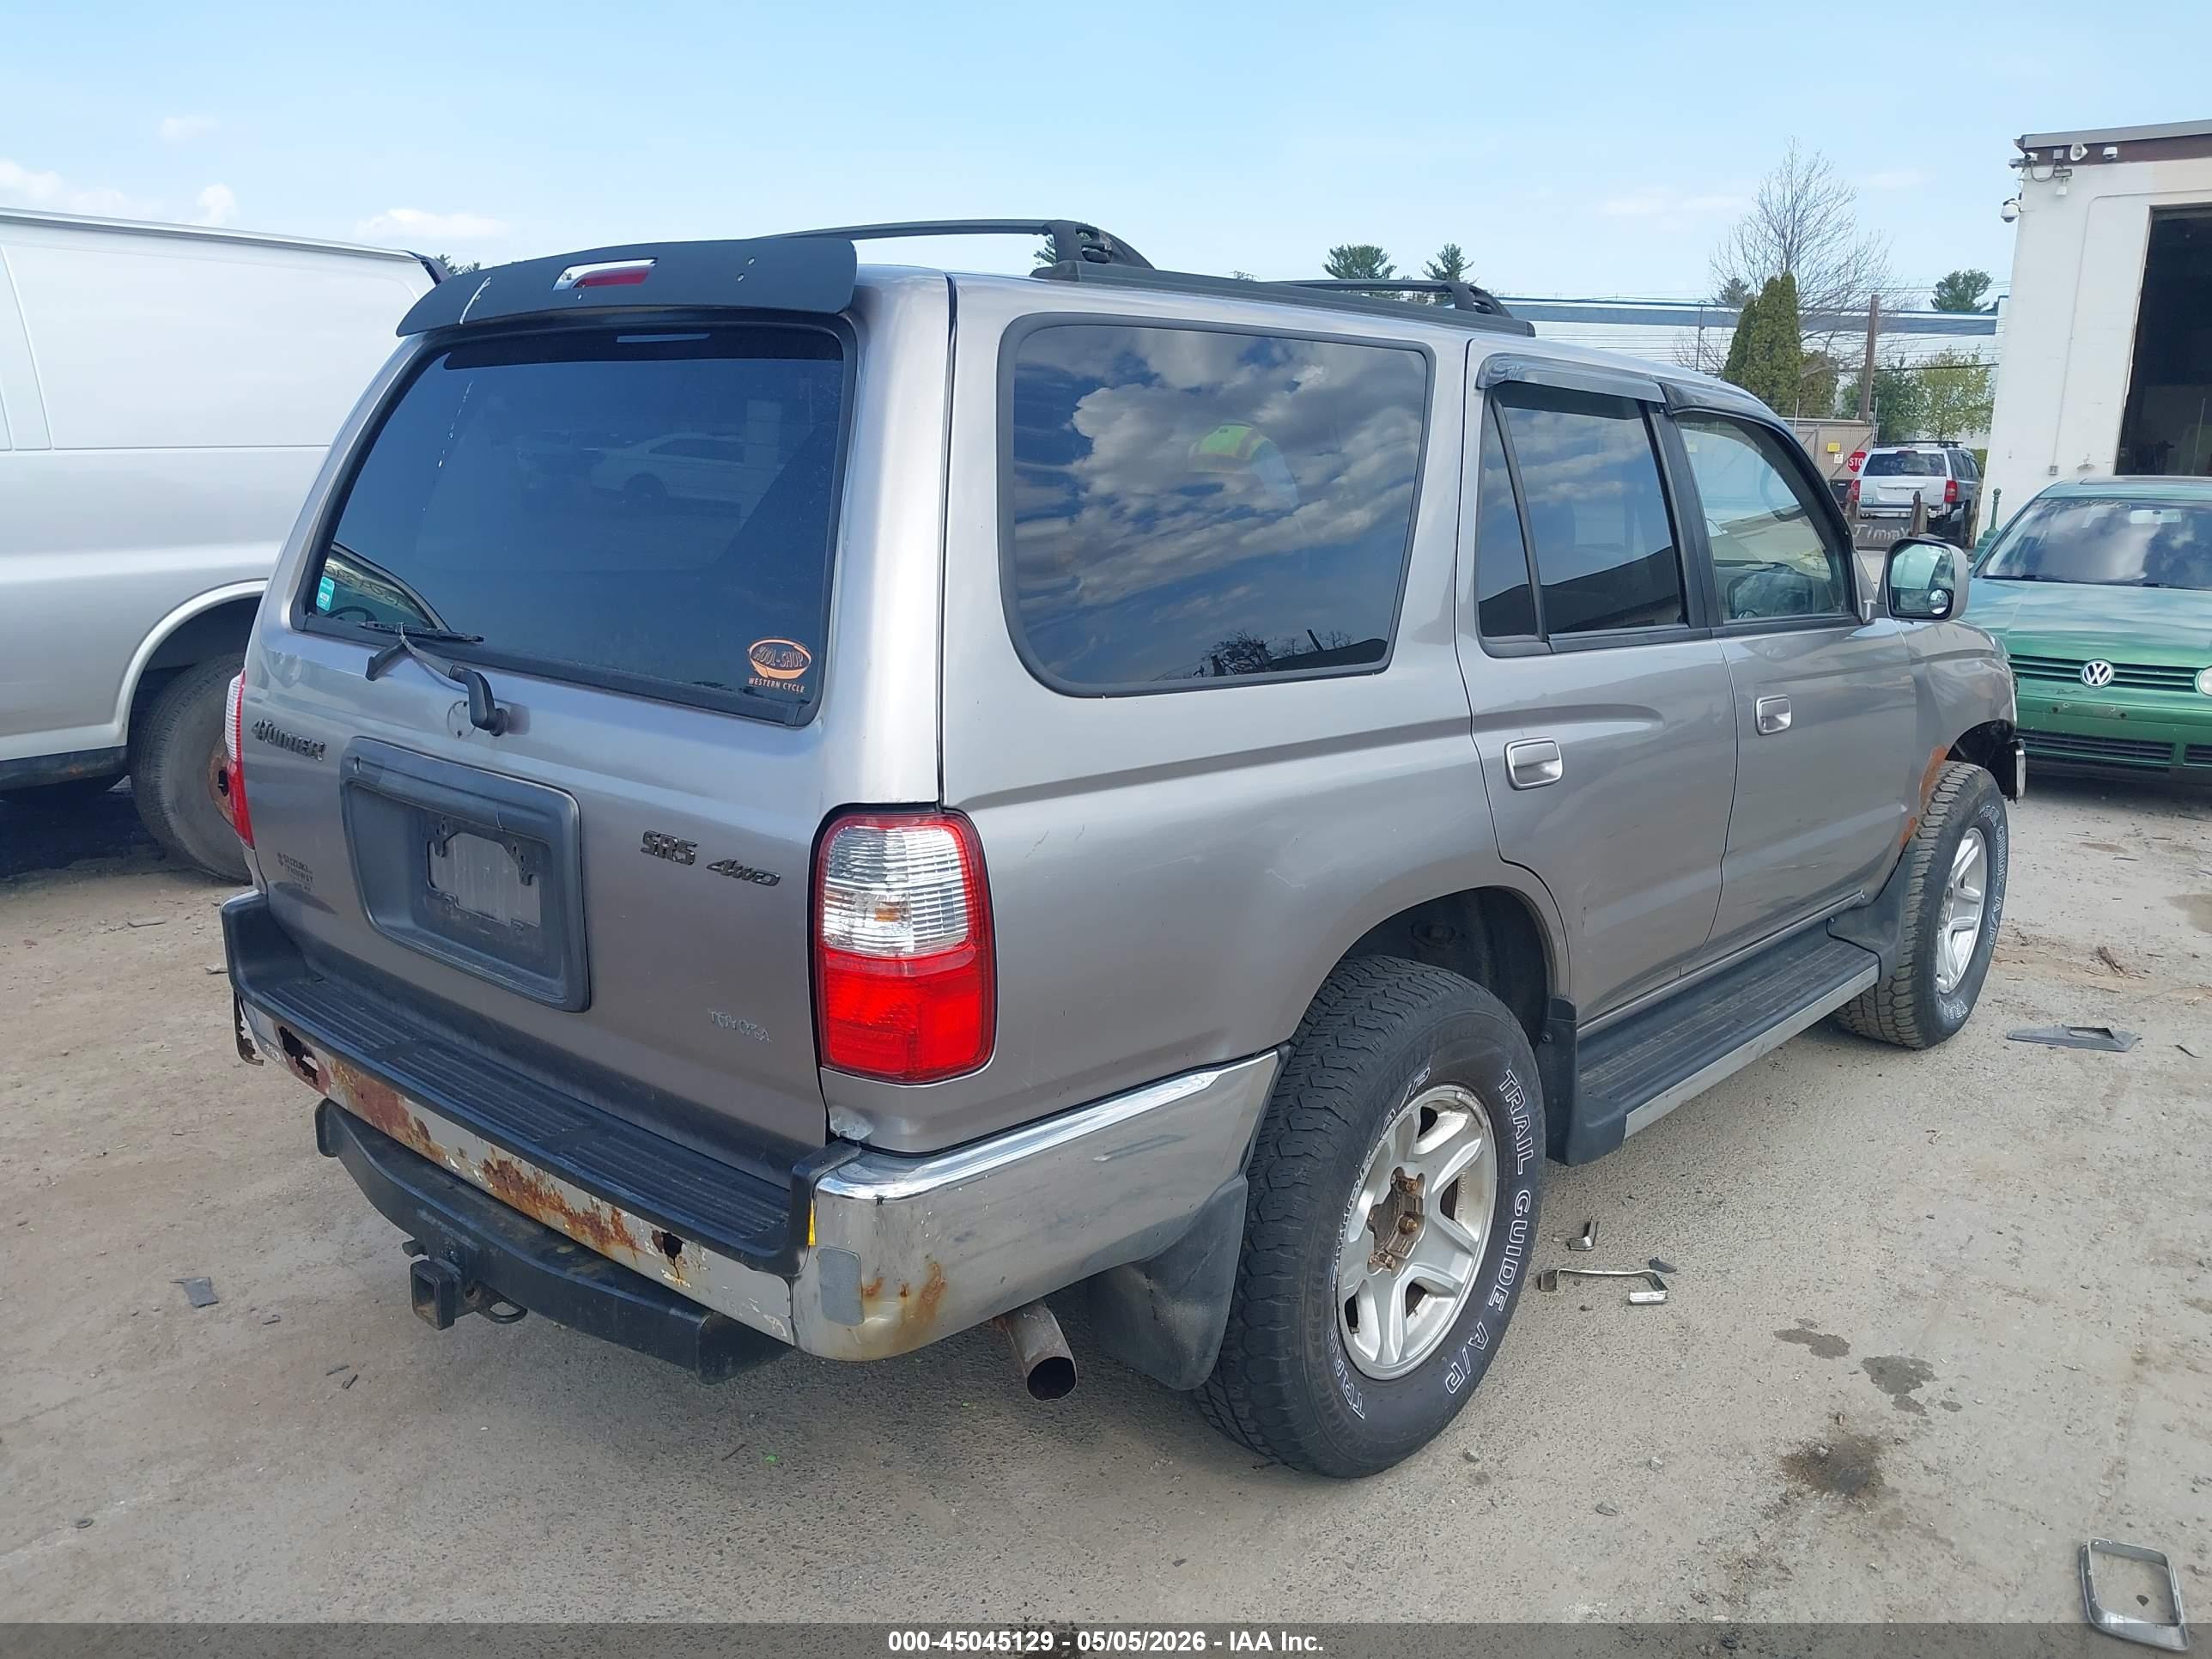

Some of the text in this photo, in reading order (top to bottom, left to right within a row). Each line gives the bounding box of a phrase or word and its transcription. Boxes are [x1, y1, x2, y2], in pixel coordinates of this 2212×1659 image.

[1849, 458, 1863, 466] STO
[748, 678, 805, 693] WESTERN CYCLE
[2082, 661, 2112, 686] VW
[641, 830, 697, 866] SR5
[1996, 825, 2007, 887] GUIDE
[1988, 895, 2002, 945] A/P
[1445, 1068, 1534, 1394] TRAIL GUIDE A/P
